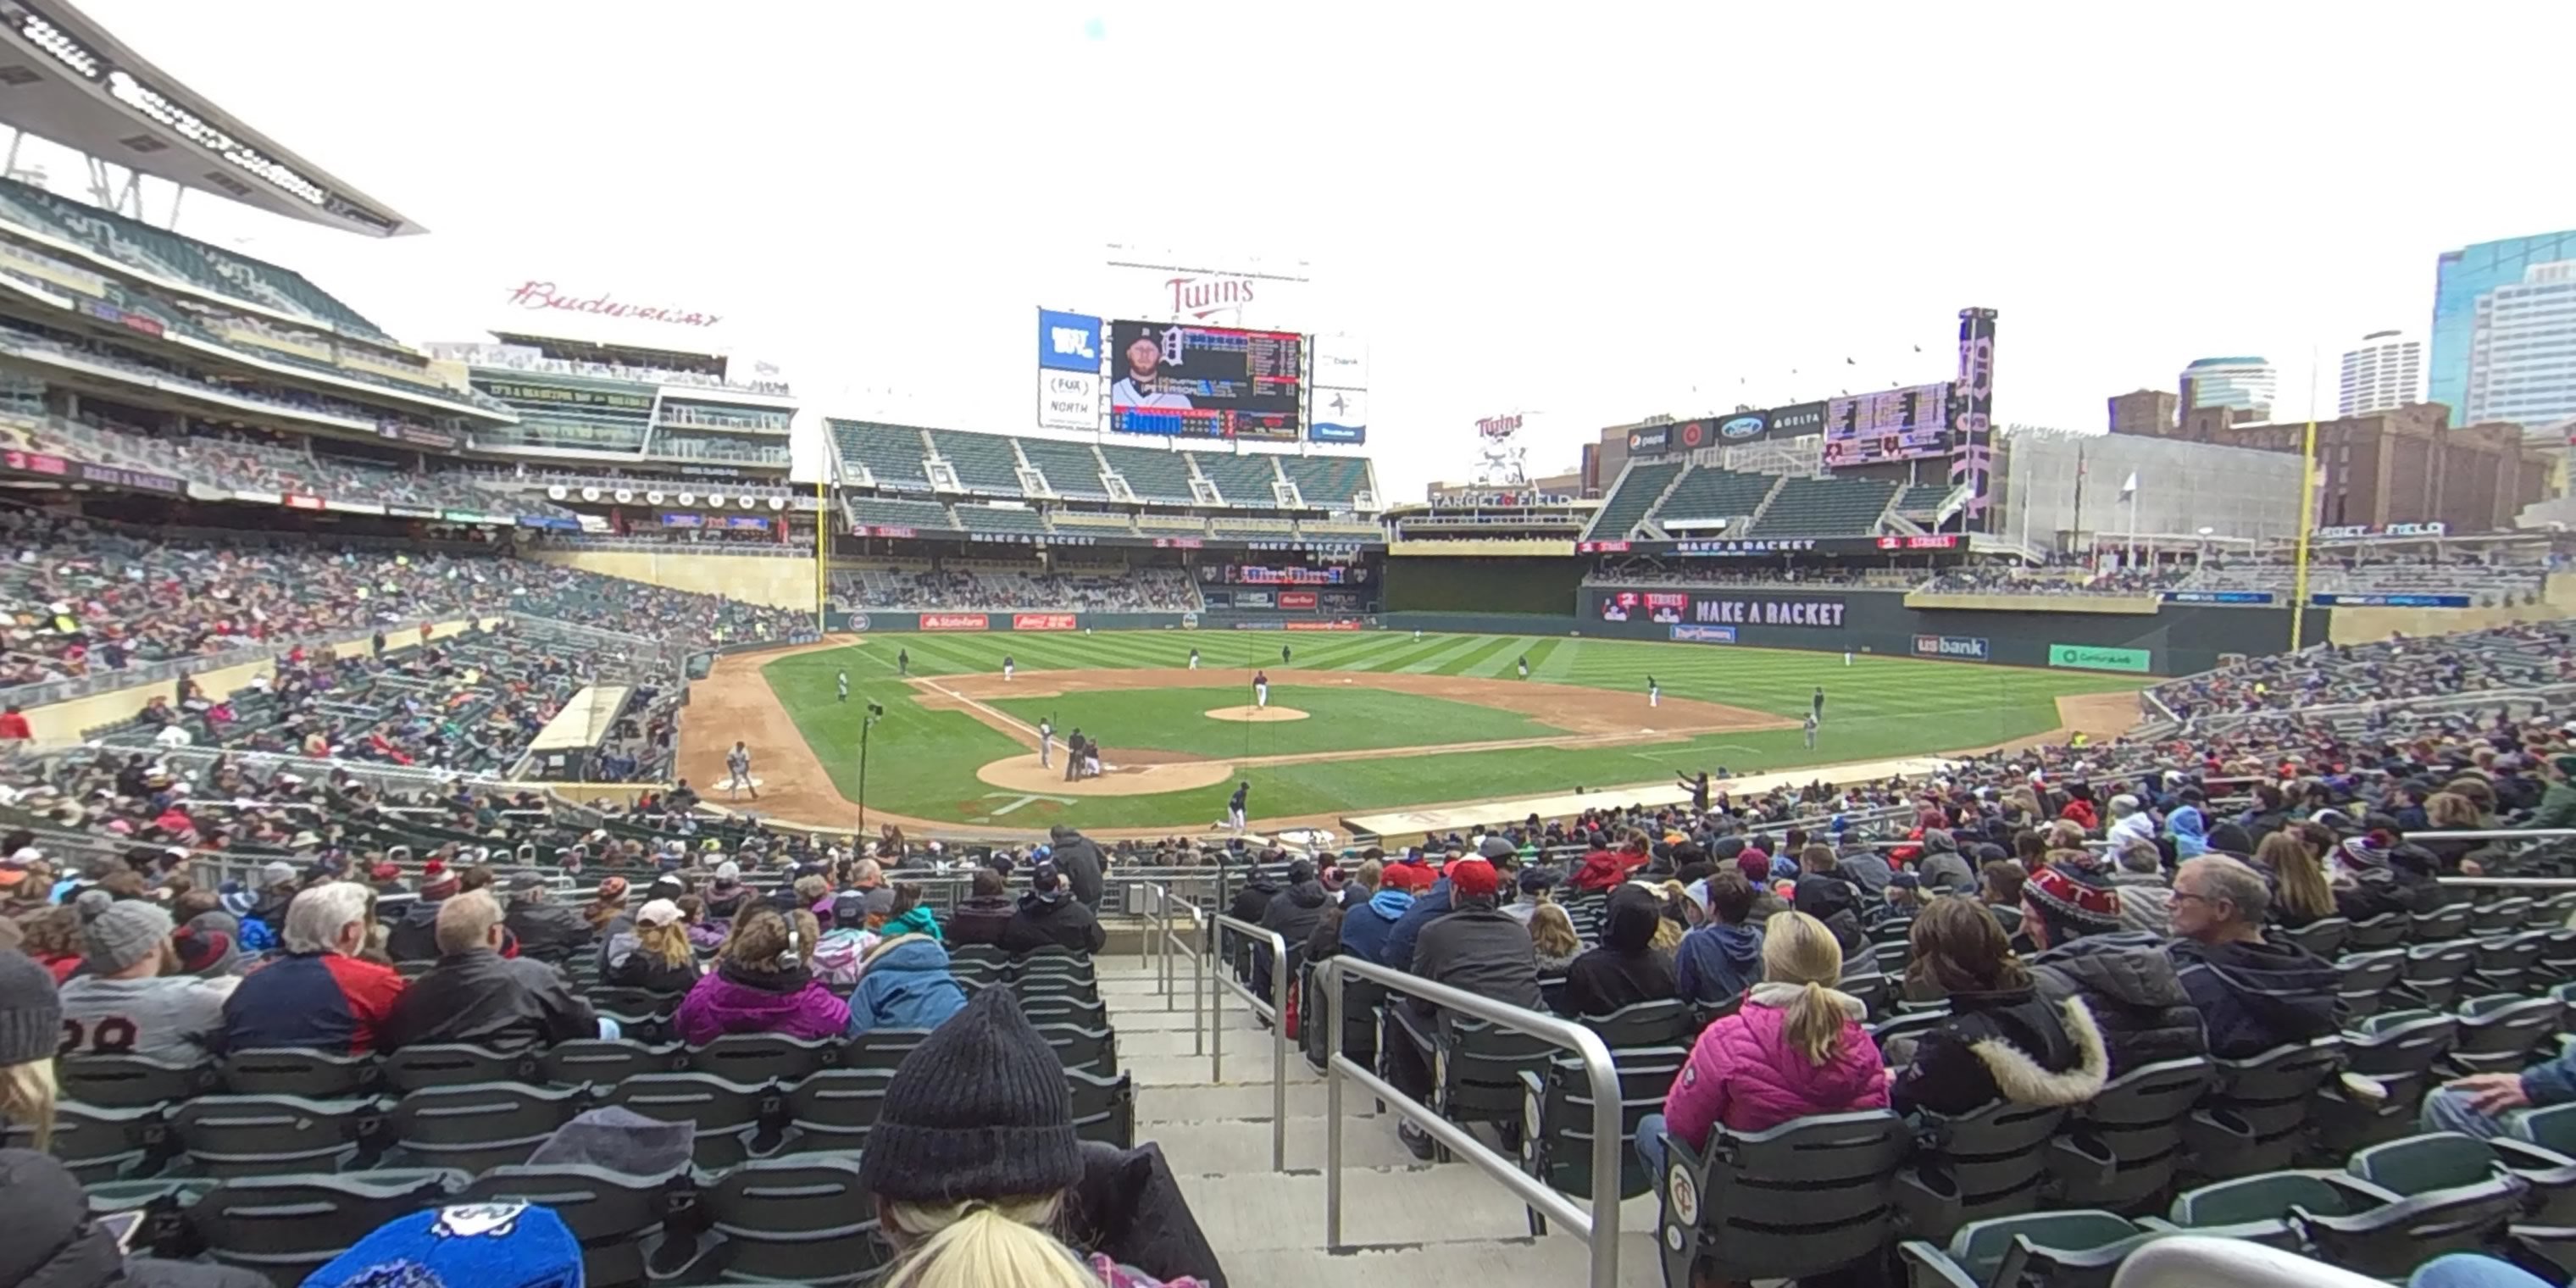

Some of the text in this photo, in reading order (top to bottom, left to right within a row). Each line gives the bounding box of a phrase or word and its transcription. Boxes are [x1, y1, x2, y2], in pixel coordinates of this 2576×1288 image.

[1165, 278, 1254, 314] Twins
[506, 280, 725, 327] Budweiser
[1058, 379, 1081, 391] FOX
[1050, 401, 1089, 414] NORTH
[1475, 414, 1523, 437] Twins
[1784, 413, 1820, 427] DELTA
[1641, 432, 1666, 447] pepsi
[1431, 494, 1574, 508] TARGET FIELD
[970, 533, 1096, 546] MAKE A RACKET
[1677, 541, 1816, 551] MAKE A RACKET
[1621, 593, 1635, 604] 2
[1696, 602, 1845, 625] MAKE A RACKET
